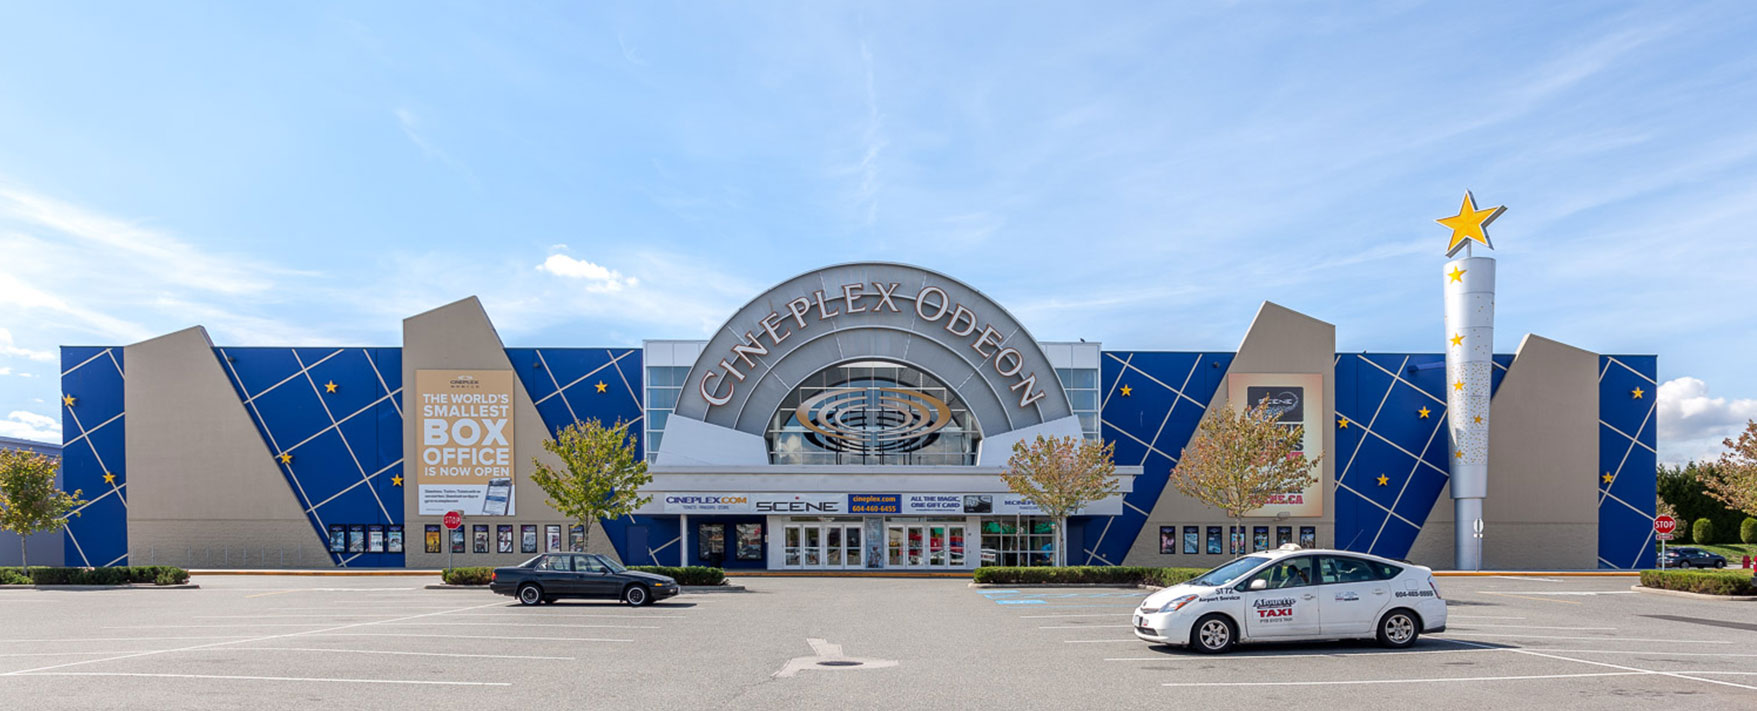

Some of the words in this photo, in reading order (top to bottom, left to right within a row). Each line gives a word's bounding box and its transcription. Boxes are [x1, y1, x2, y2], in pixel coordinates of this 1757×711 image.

[699, 282, 901, 407] CINEPLEX
[915, 285, 1047, 410] ODEON
[422, 393, 448, 404] THE
[450, 393, 509, 404] WORLD'S
[423, 405, 509, 417] SMALLEST
[424, 418, 509, 446] BOX
[423, 448, 509, 465] OFFICE
[424, 466, 437, 477] IS
[439, 466, 471, 477] NOW
[474, 466, 510, 477] OPEN
[665, 496, 747, 504] CINEPLEX.COM
[852, 495, 896, 504] cineplex.com
[756, 501, 840, 512] SCENE
[852, 505, 897, 513] 604-460-6455
[444, 515, 461, 525] STOP
[1655, 520, 1674, 529] STOP
[1257, 608, 1292, 617] TAXI
